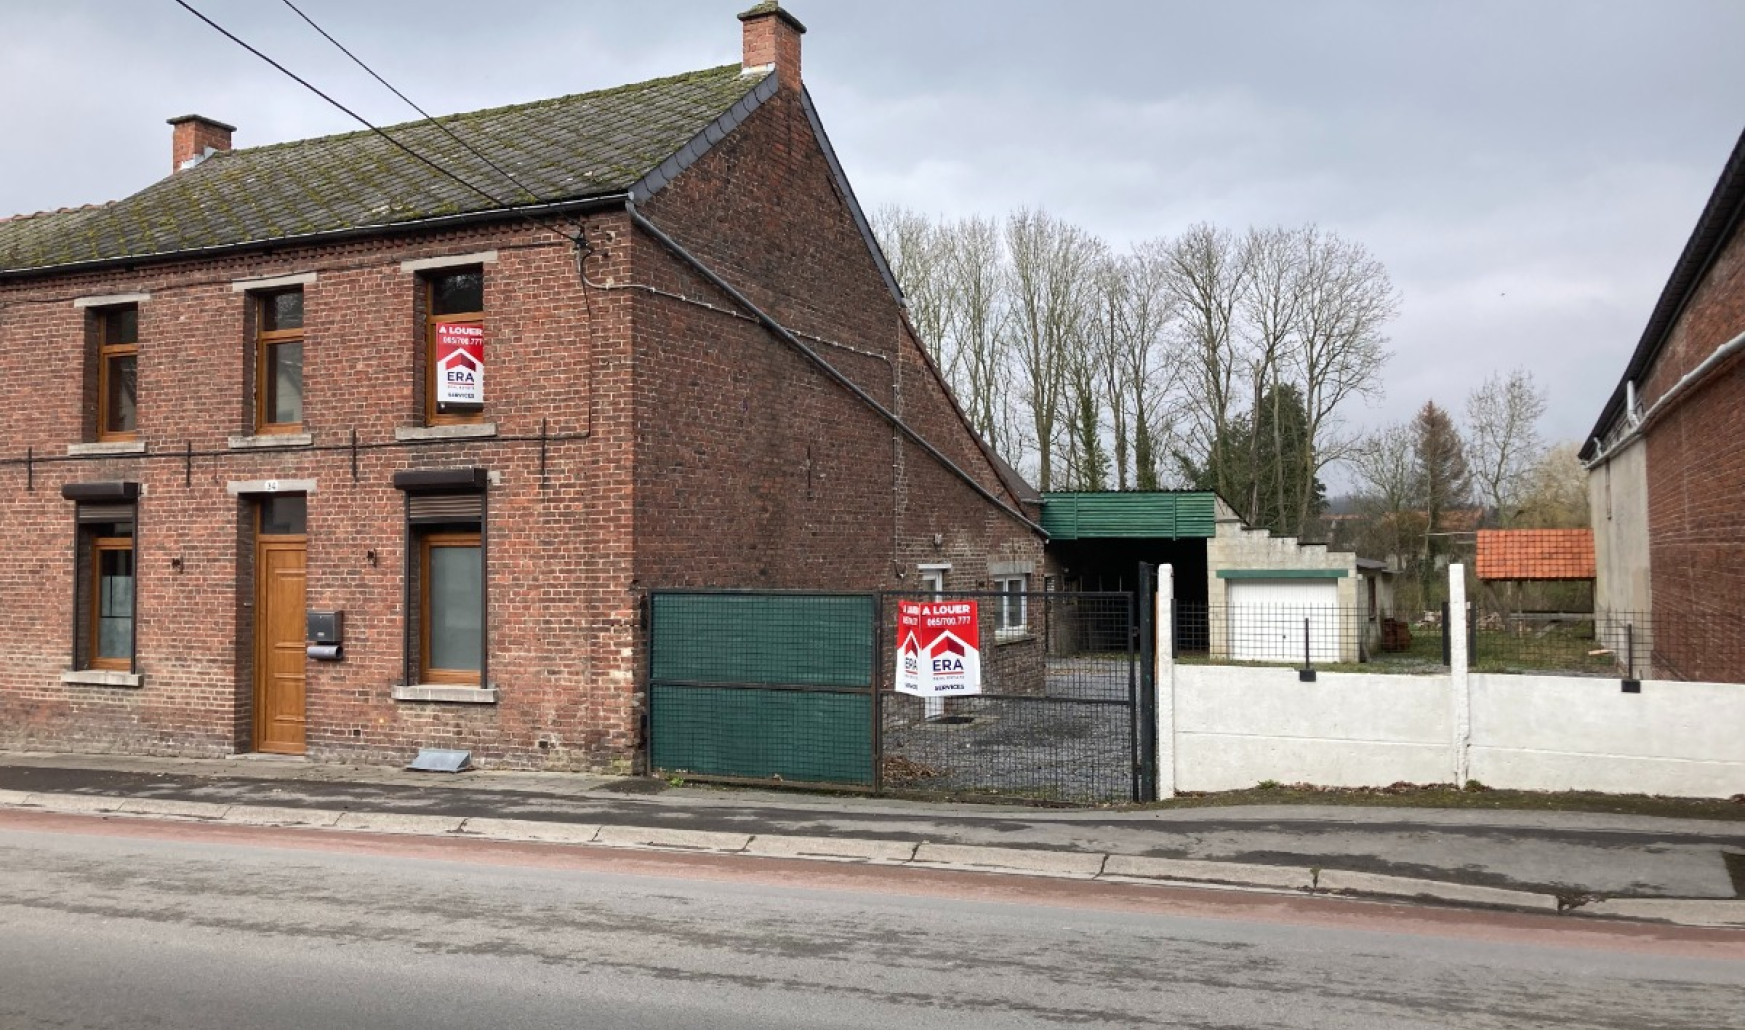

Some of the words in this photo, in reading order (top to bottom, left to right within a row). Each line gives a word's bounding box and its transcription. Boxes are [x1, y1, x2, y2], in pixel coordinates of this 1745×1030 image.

[438, 325, 447, 334] A
[448, 326, 483, 336] LOUER
[447, 371, 475, 383] ERA
[921, 605, 931, 615] A
[933, 604, 971, 614] LOUER
[932, 658, 964, 672] ERA
